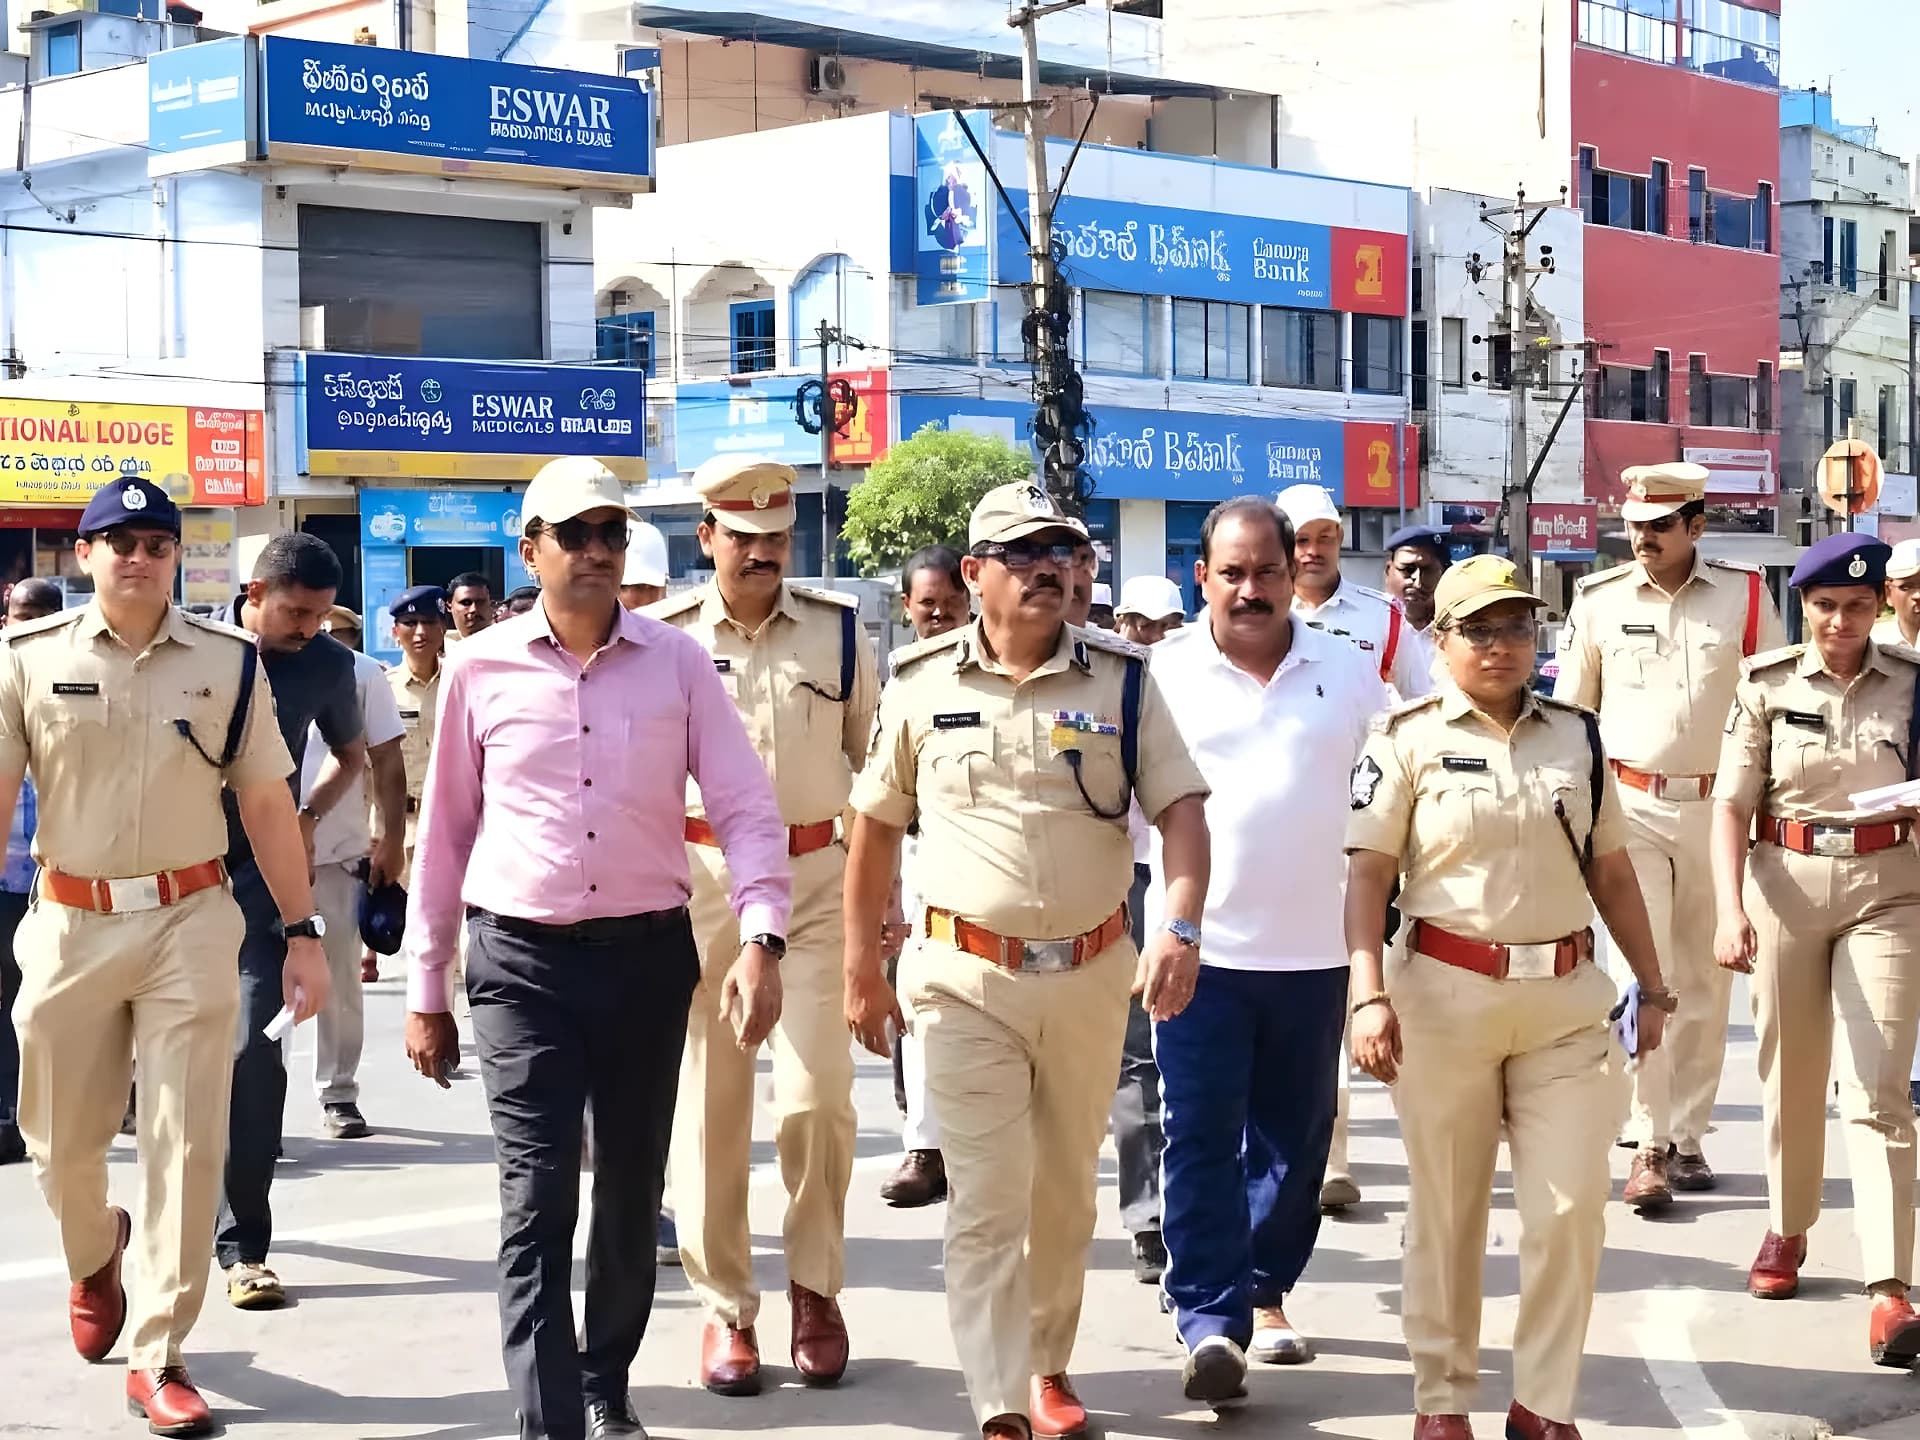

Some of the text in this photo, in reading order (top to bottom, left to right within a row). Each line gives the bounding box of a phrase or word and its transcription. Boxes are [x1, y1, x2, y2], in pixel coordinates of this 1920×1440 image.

[489, 85, 614, 131] ESWAR
[472, 394, 554, 419] ESWAR
[97, 420, 174, 446] LODGE
[472, 420, 555, 434] MEDICALS
